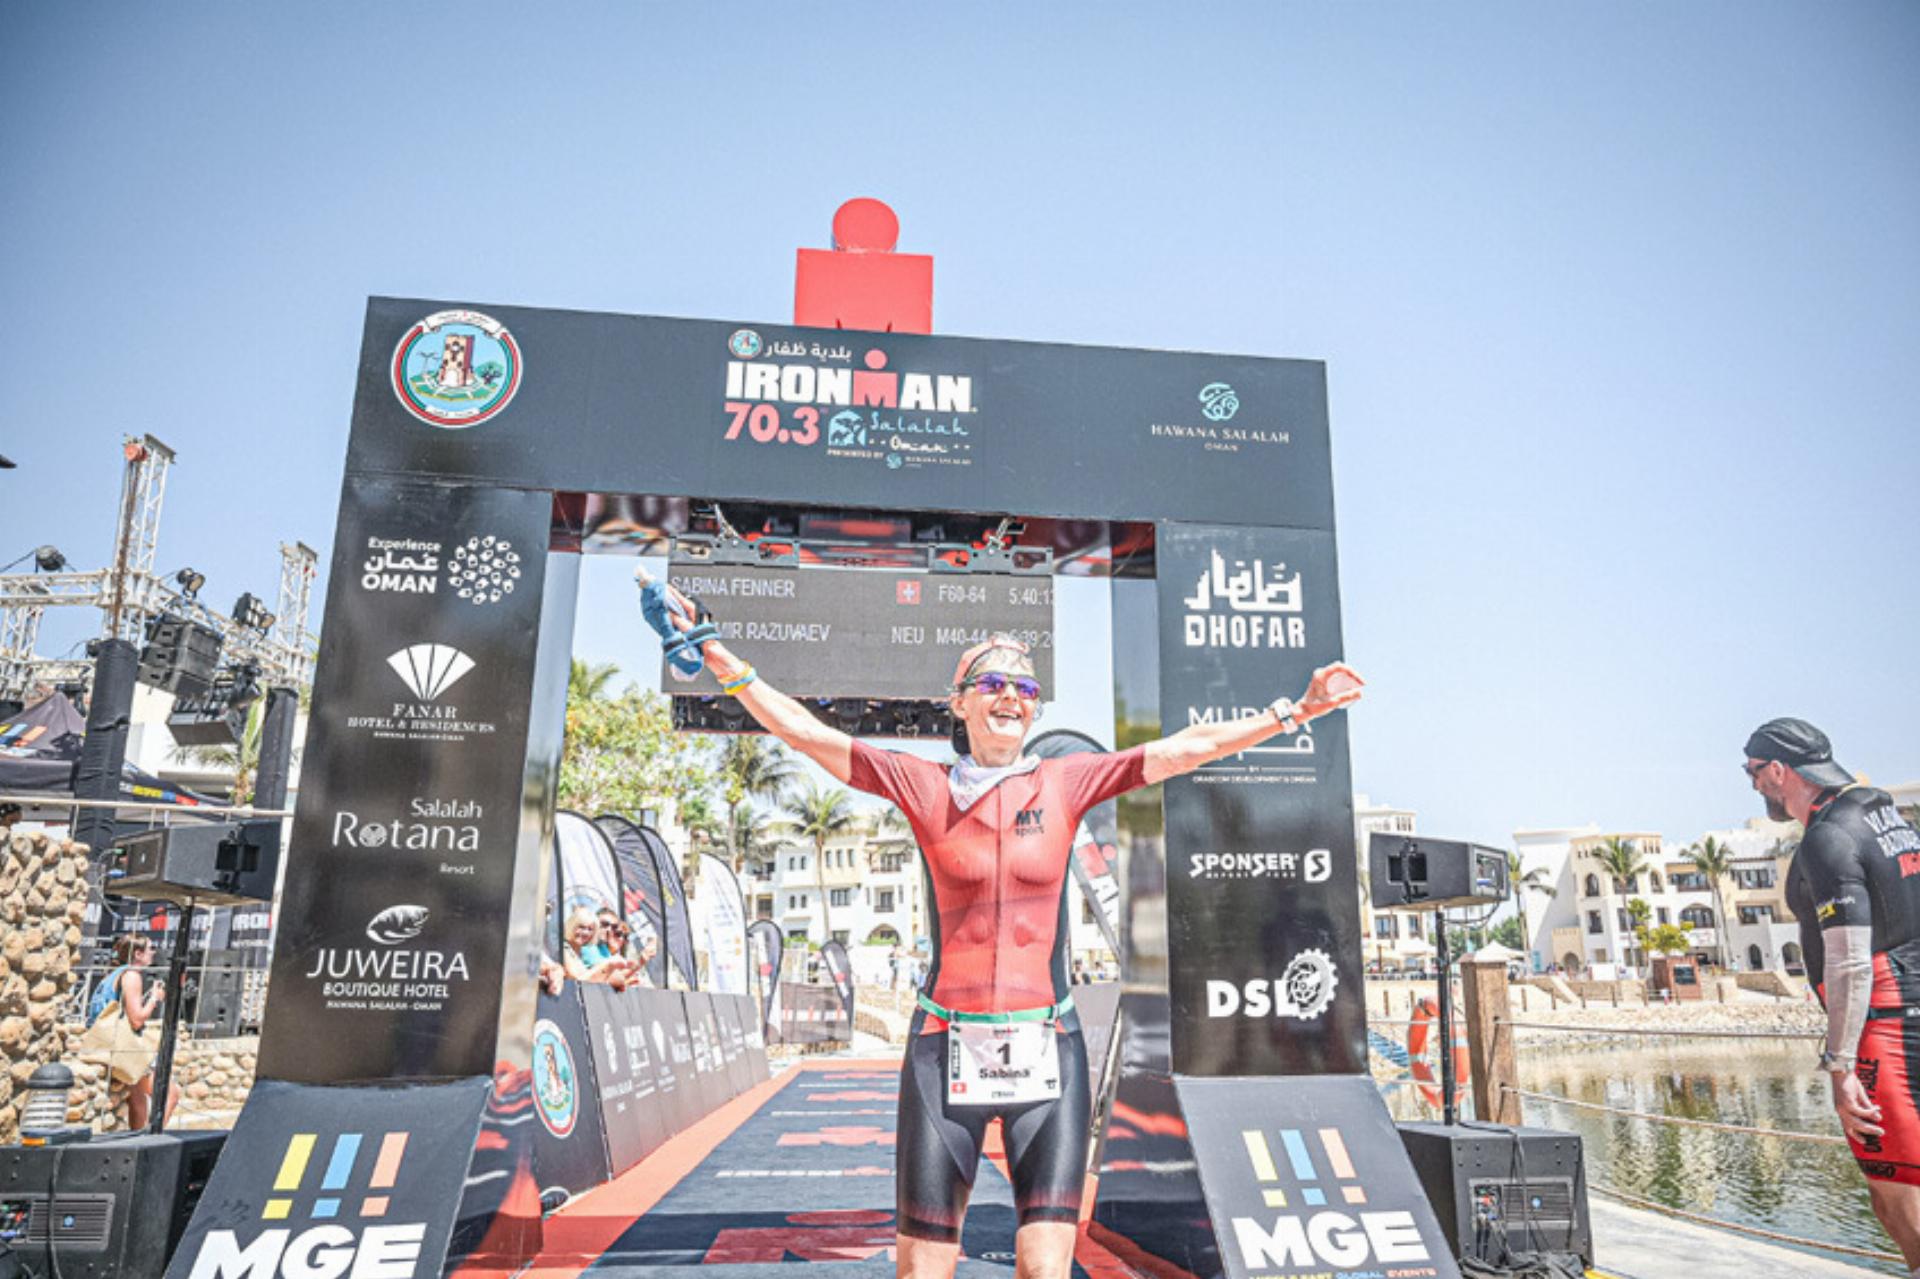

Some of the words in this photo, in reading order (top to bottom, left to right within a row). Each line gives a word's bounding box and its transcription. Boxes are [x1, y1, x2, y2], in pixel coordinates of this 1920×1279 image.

[725, 349, 974, 412] IRONMAN
[724, 402, 820, 446] 70.3
[1151, 424, 1217, 439] HAWANA
[1221, 428, 1290, 444] SALALAH
[368, 536, 441, 553] Experience
[361, 573, 437, 594] OMAN
[671, 576, 727, 595] SABINA
[731, 578, 795, 598] FENNER
[1008, 587, 1052, 606] 5:40:1
[746, 621, 831, 642] RAZUVAEV
[891, 626, 925, 645] NEU
[1184, 614, 1306, 648] DHOFAR
[393, 703, 458, 719] FANAR
[348, 717, 394, 729] HOTEL
[411, 719, 496, 733] RESIDENCES
[411, 798, 482, 819] Salalah
[1016, 808, 1043, 826] MY
[332, 812, 479, 851] Rotana
[440, 863, 474, 875] Resort
[1189, 853, 1298, 878] SPONSER
[306, 949, 469, 981] JUWEIRA
[323, 982, 400, 997] BOUTIQUE
[404, 983, 449, 998] HOTEL
[997, 1043, 1010, 1065] 1
[980, 1068, 1030, 1079] Sabina
[188, 1222, 427, 1279] MGE
[1231, 1211, 1431, 1269] MGE
